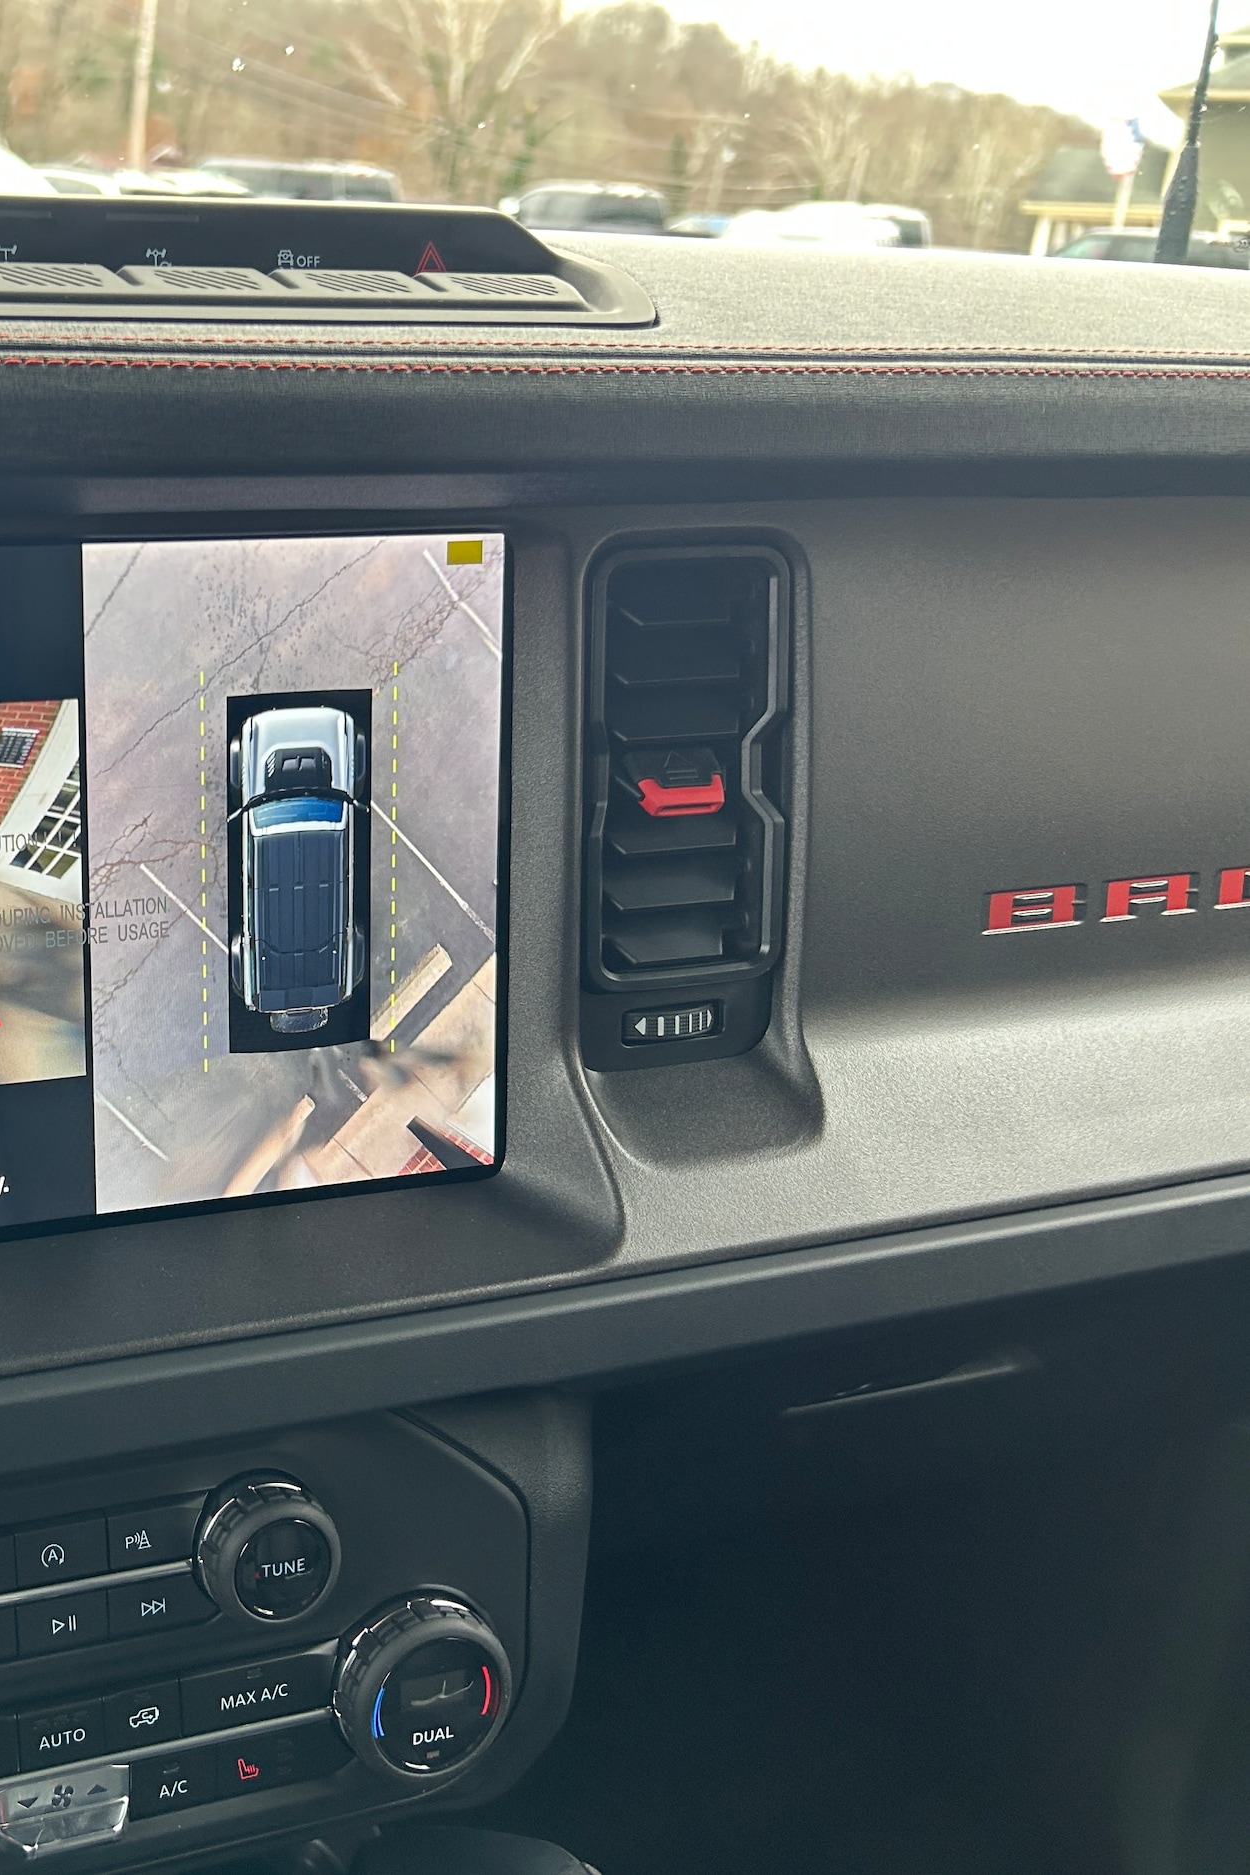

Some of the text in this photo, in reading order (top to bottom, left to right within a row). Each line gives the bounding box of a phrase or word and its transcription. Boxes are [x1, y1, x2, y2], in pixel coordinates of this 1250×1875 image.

[296, 255, 320, 268] OFF
[60, 896, 168, 922] INSTALLATION
[45, 926, 108, 948] BEFORE
[117, 920, 170, 942] USAGE
[261, 1557, 306, 1578] TUNE
[220, 1683, 289, 1711] MAX A/C
[38, 1728, 87, 1751] AUTO
[412, 1726, 455, 1746] DUAL
[159, 1779, 188, 1799] A/C
